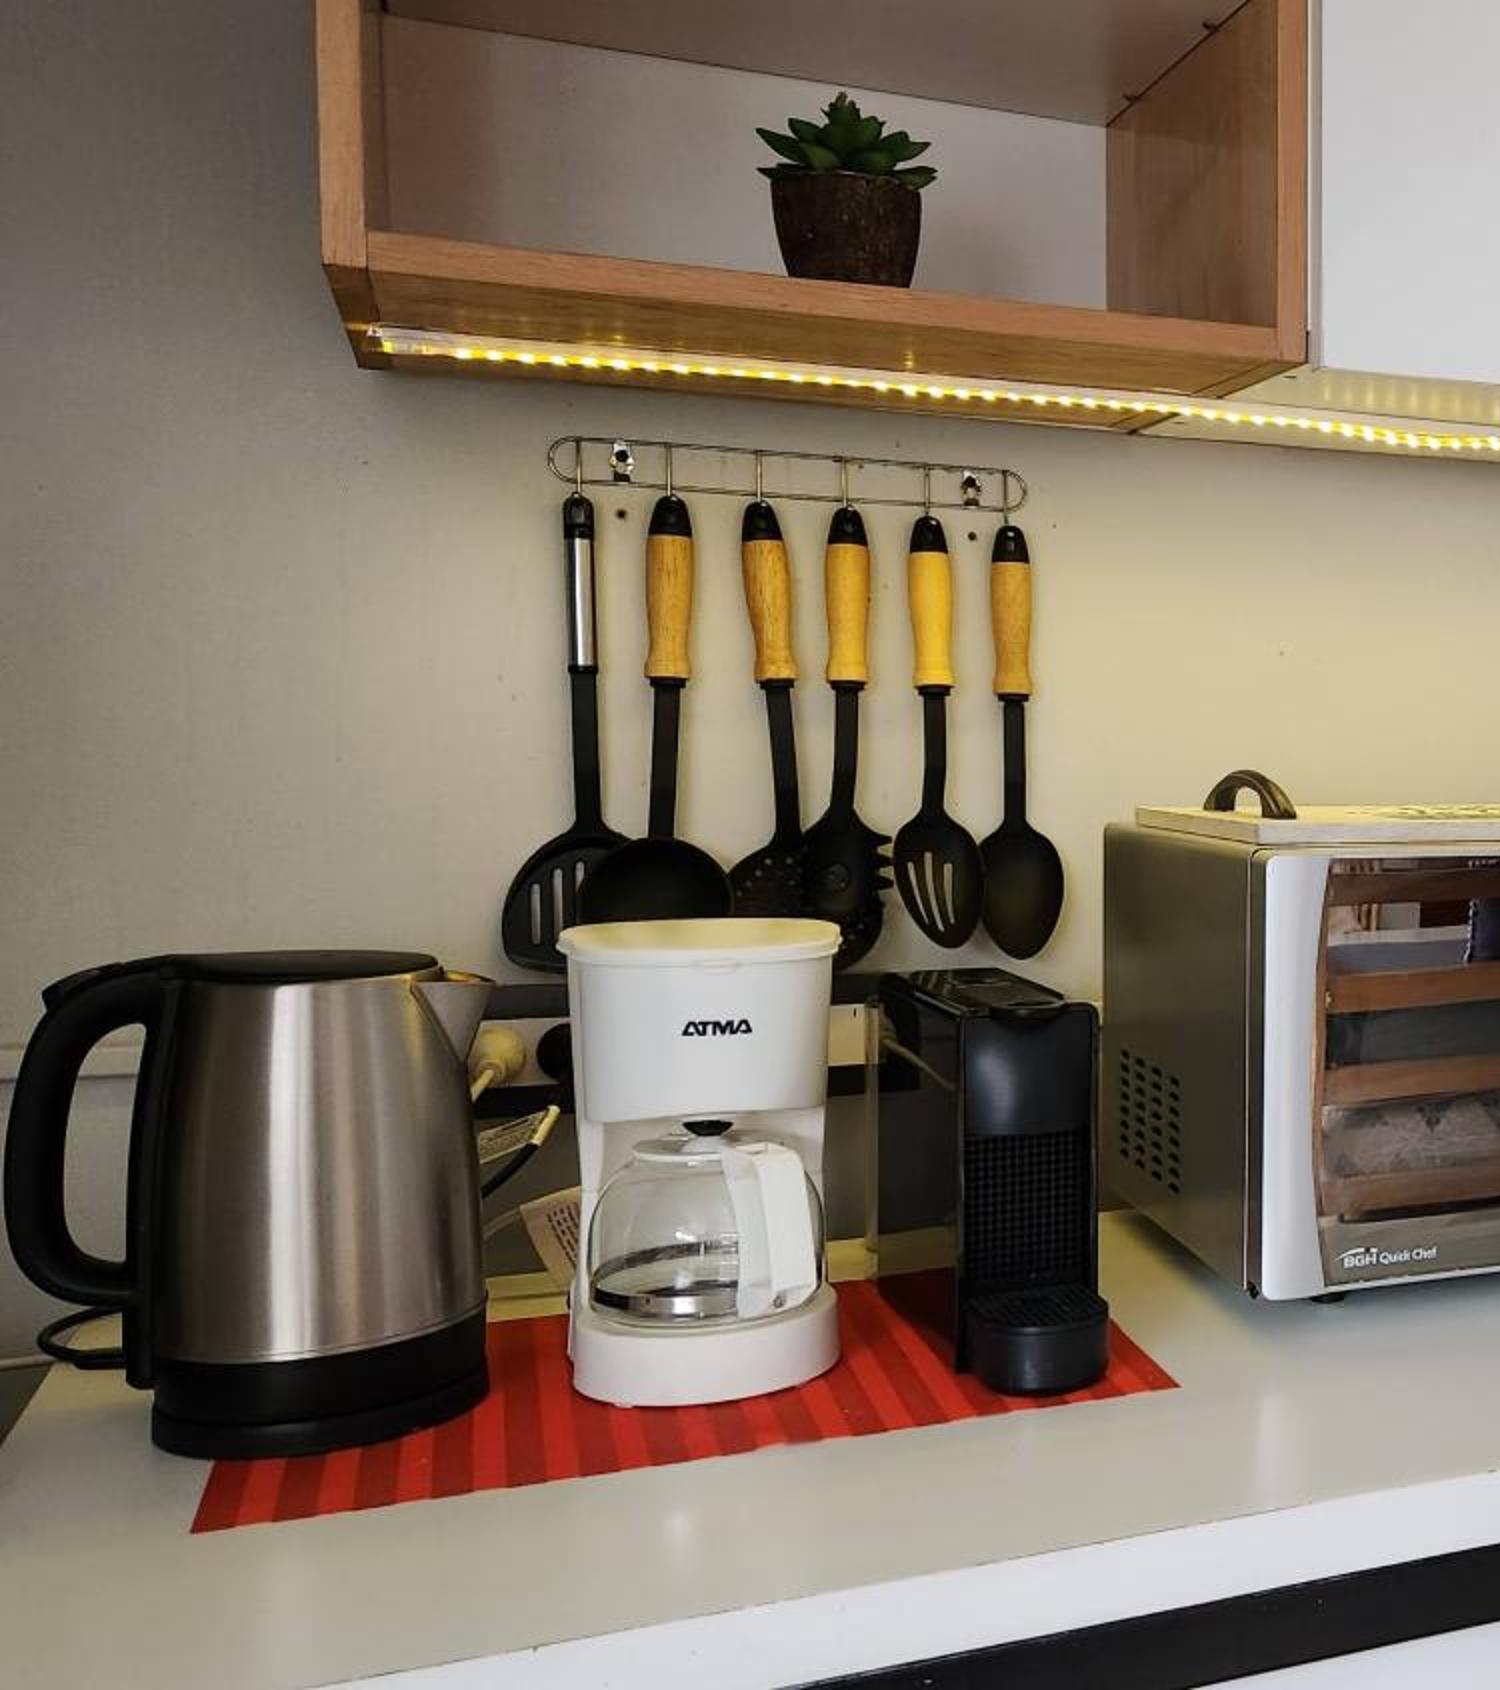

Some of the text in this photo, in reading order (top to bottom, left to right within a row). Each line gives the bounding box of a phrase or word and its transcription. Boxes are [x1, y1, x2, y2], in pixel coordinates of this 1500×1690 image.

[682, 1019, 753, 1036] ATMA
[1341, 1247, 1438, 1269] BGH Quick Chef
